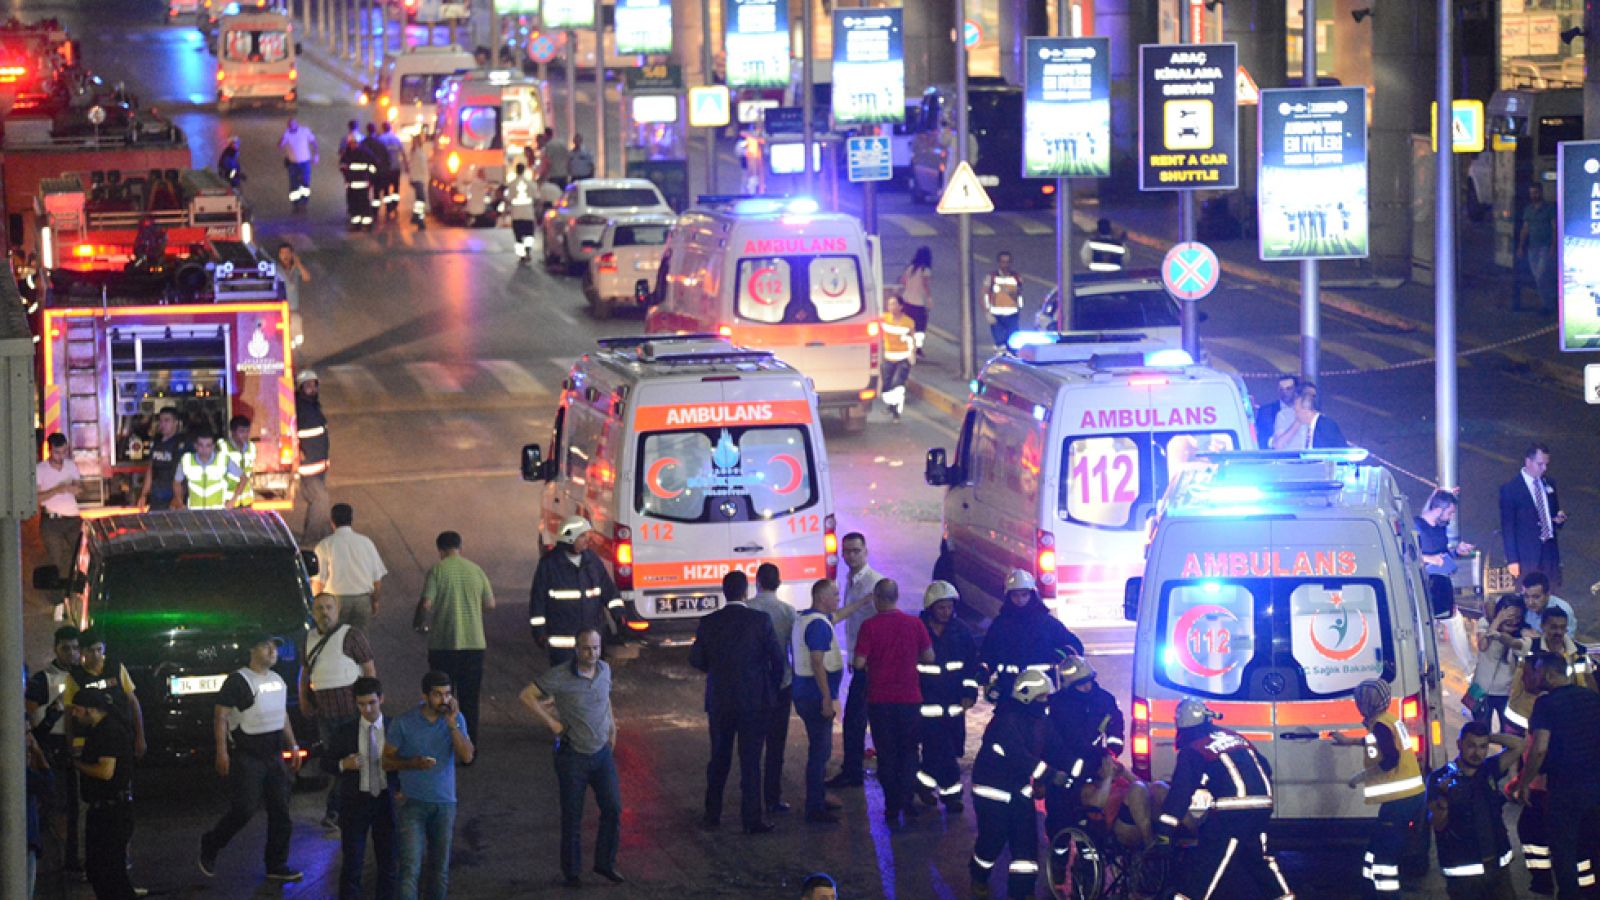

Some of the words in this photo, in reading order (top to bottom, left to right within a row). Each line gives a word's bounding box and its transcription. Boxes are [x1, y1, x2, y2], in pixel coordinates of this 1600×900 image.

[1170, 51, 1207, 65] ARAÇ
[1150, 155, 1185, 166] RENT
[1187, 155, 1198, 166] A
[1200, 153, 1228, 165] CAR
[1159, 169, 1219, 181] SHUTTLE
[744, 237, 847, 254] AMBULANS
[757, 280, 782, 294] 112
[666, 404, 773, 425] AMBULANS
[1080, 406, 1217, 428] AMBULANS
[1073, 453, 1136, 503] 112
[640, 522, 674, 541] 112
[787, 514, 820, 534] 112
[1181, 550, 1357, 577] AMBULANS
[658, 598, 673, 612] 34
[1189, 628, 1231, 654] 112
